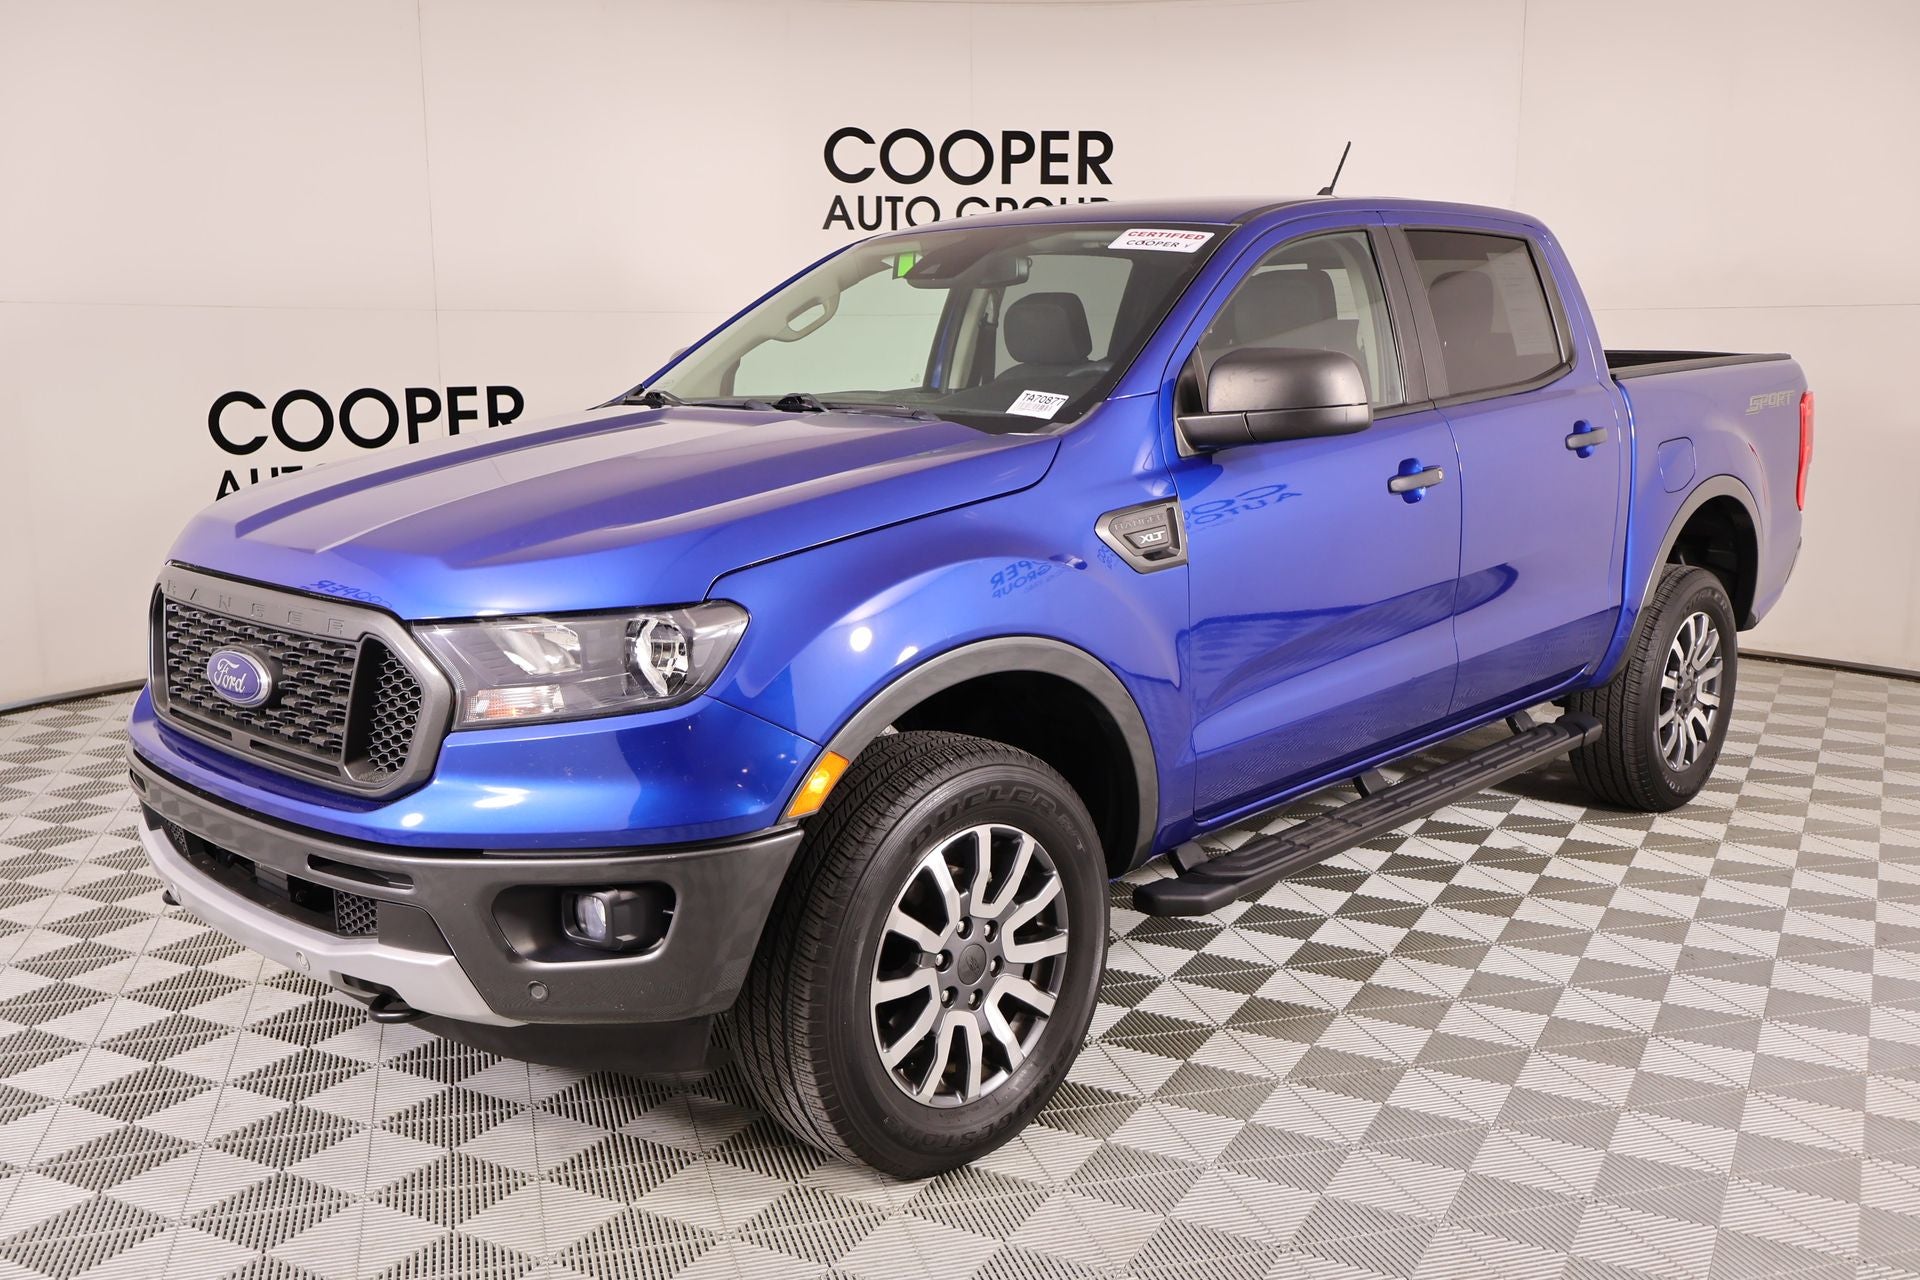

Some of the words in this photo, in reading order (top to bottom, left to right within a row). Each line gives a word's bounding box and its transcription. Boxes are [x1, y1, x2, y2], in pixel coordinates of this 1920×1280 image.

[823, 126, 1114, 186] COOPER
[822, 194, 941, 231] AUTO
[1126, 240, 1180, 248] COOPER
[1127, 231, 1206, 240] CERTIFIED
[1022, 392, 1067, 407] TA70877
[1745, 390, 1795, 416] SPORT
[208, 385, 525, 456] COOPER
[1114, 512, 1165, 531] RANGER
[1139, 530, 1166, 545] XLT
[166, 578, 346, 636] RANGER
[213, 658, 247, 694] Ford
